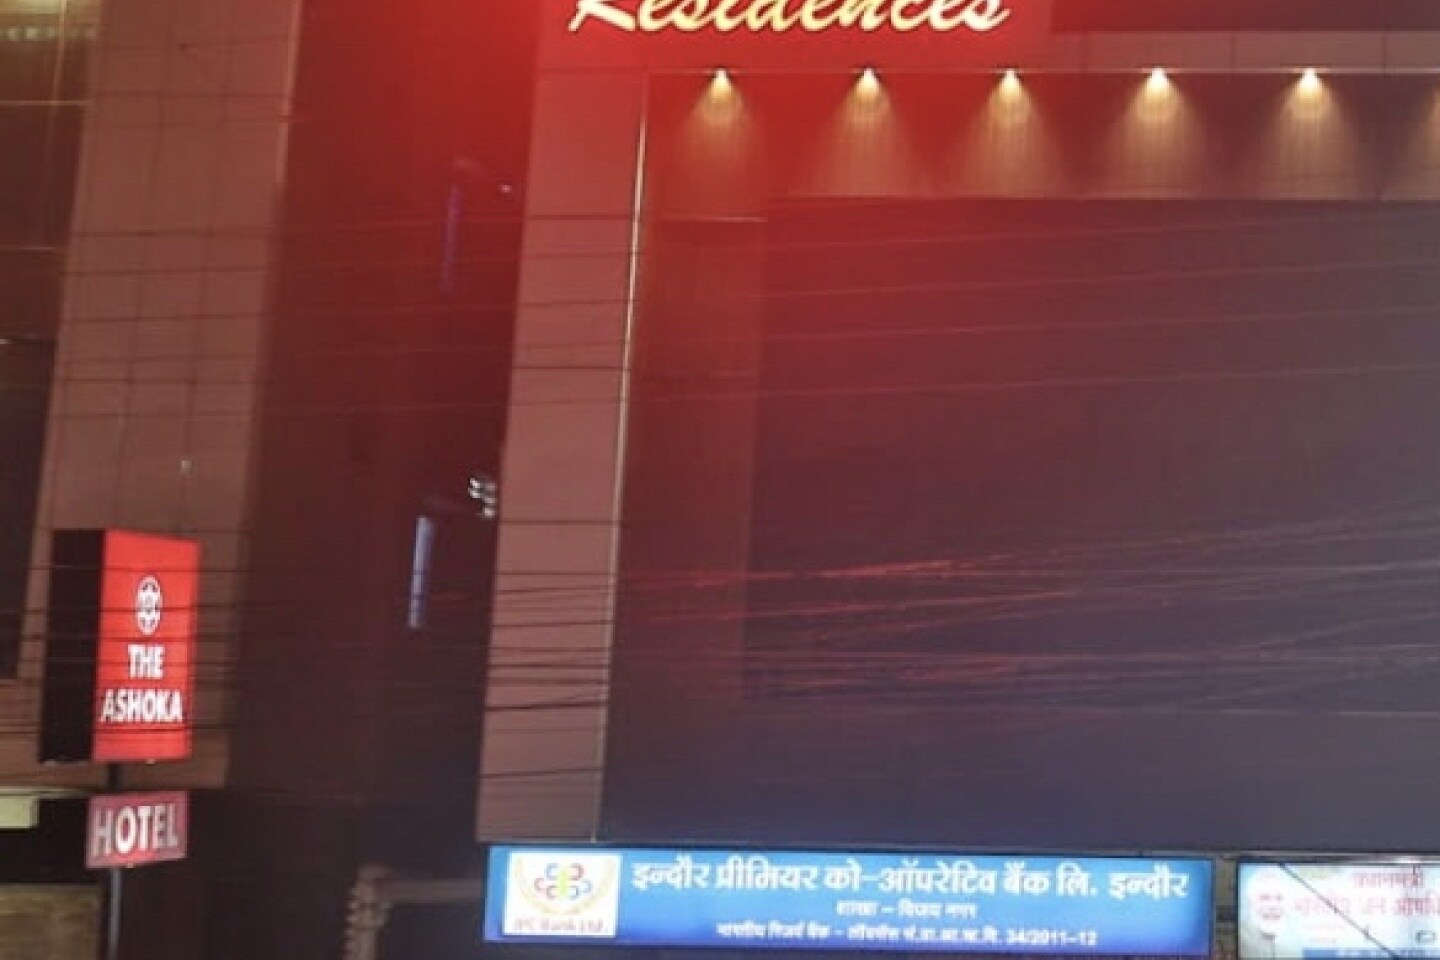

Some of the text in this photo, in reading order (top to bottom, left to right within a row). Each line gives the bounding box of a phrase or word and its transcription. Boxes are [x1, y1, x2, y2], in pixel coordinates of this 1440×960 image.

[127, 643, 165, 680] THE
[101, 689, 184, 723] ASHOKA
[92, 803, 179, 858] HOTEL
